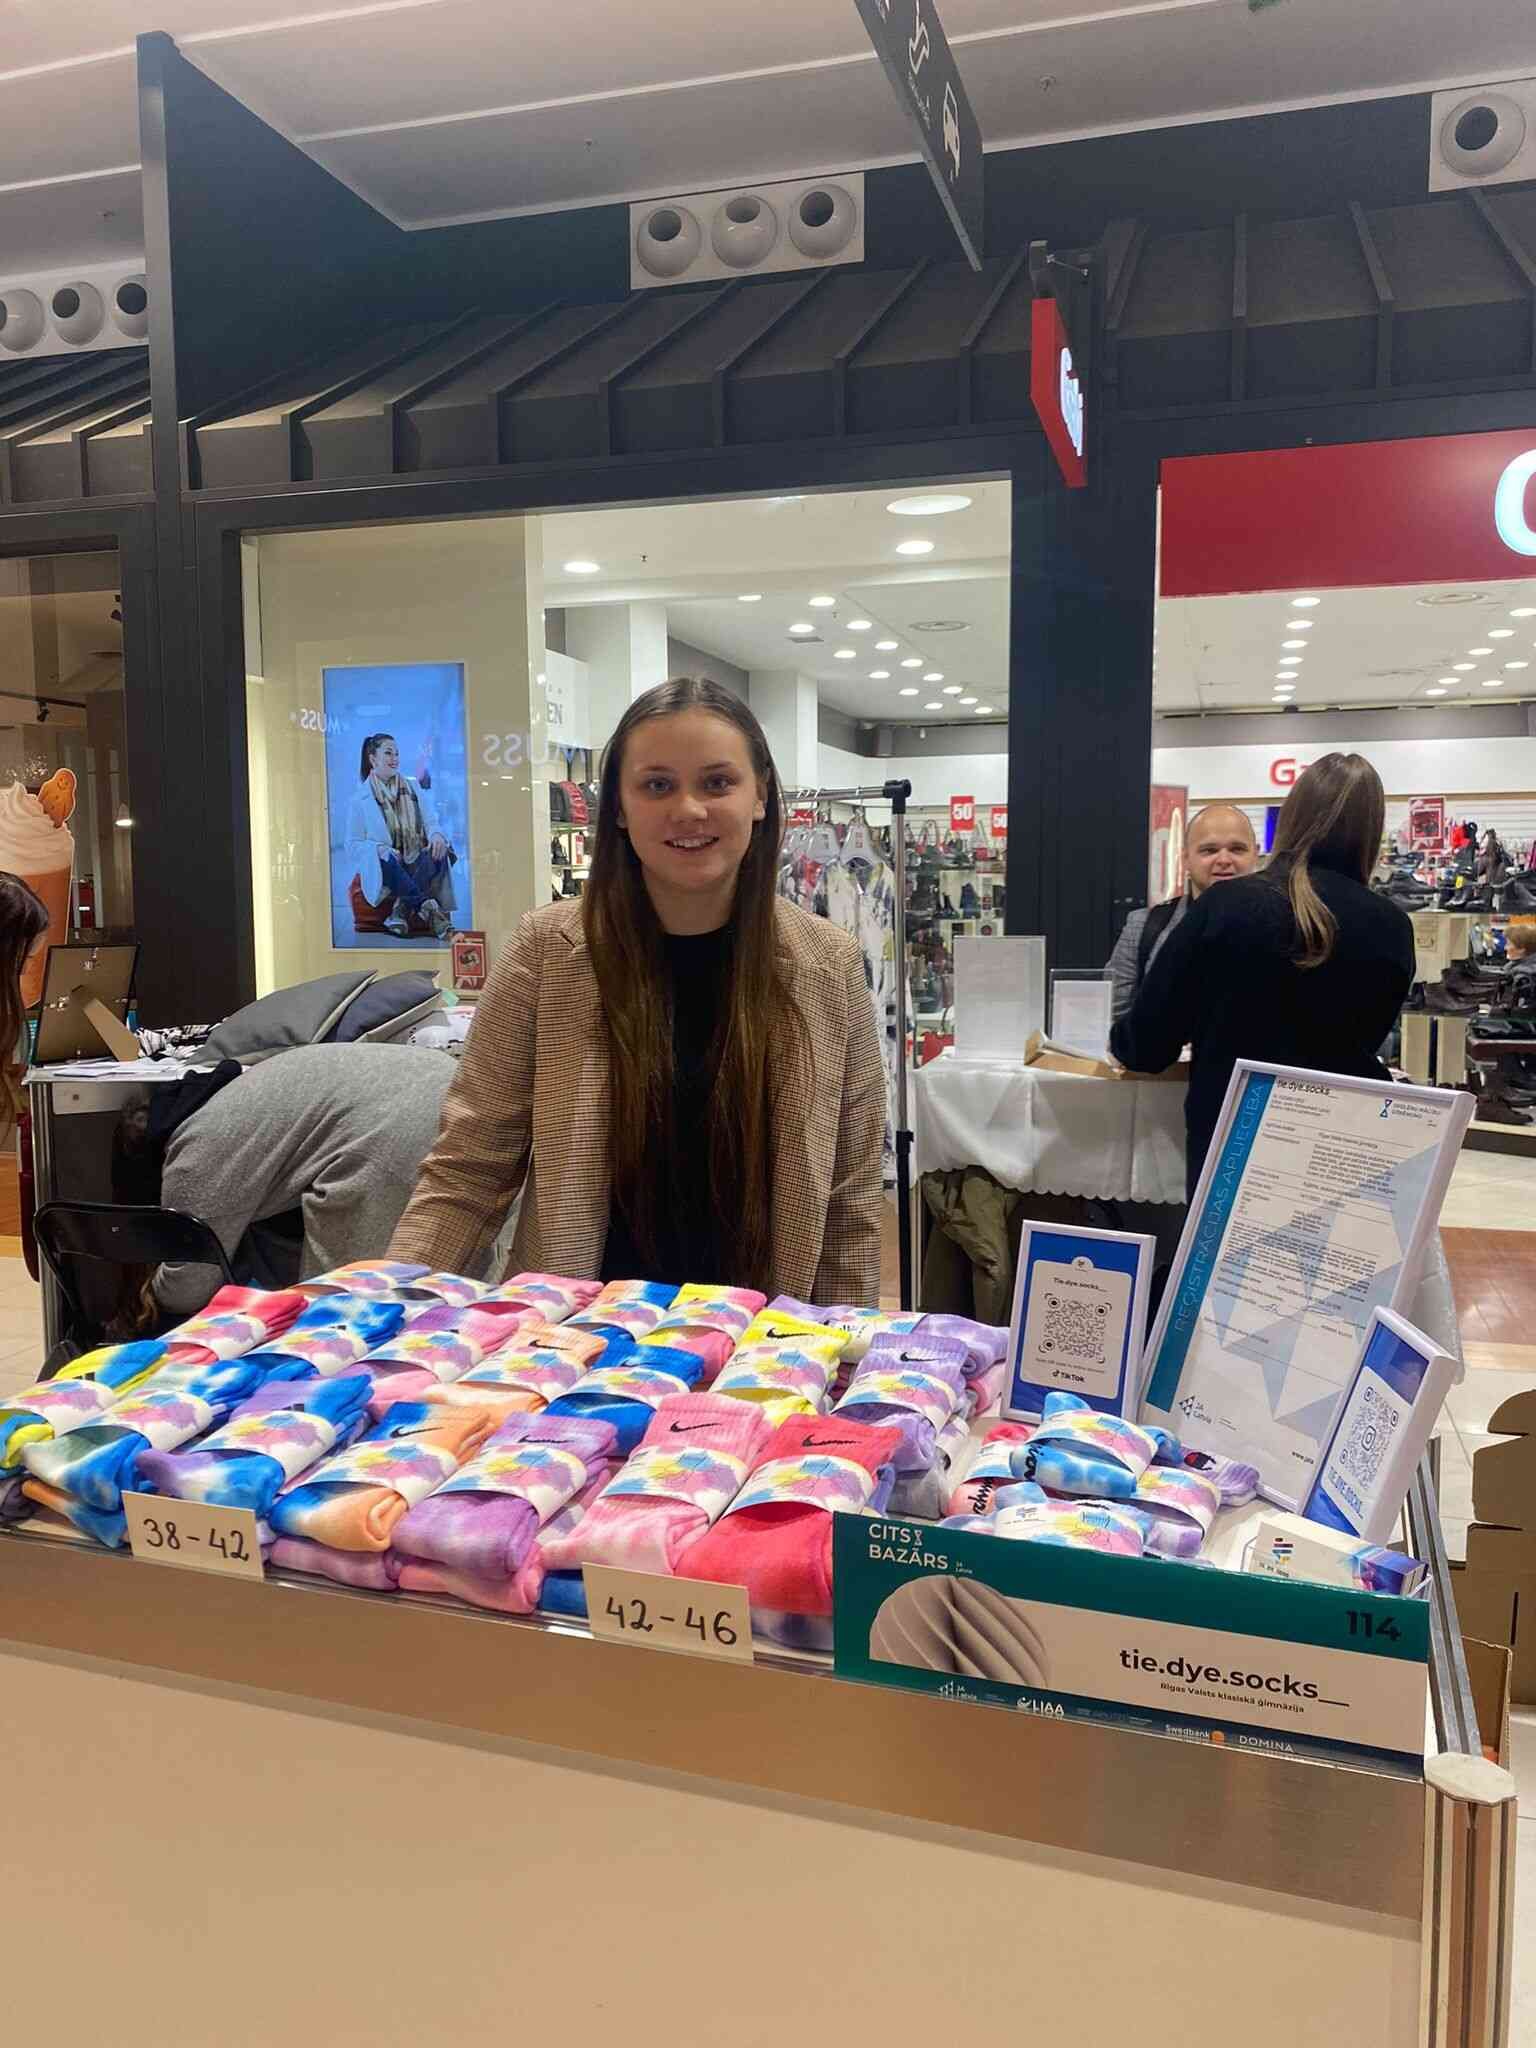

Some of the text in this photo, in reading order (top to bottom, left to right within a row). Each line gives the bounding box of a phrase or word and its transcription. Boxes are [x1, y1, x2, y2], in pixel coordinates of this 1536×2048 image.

[952, 803, 973, 821] 50
[868, 1523, 912, 1544] CITS
[868, 1544, 949, 1570] BAZĀRS
[1345, 1610, 1402, 1642] 114
[1188, 1686, 1217, 1699] Valsts
[1217, 1690, 1256, 1705] klasiskā
[1031, 1698, 1065, 1717] LIAA
[1165, 1724, 1211, 1741] Swedbank
[1238, 1734, 1296, 1753] DOMINA
